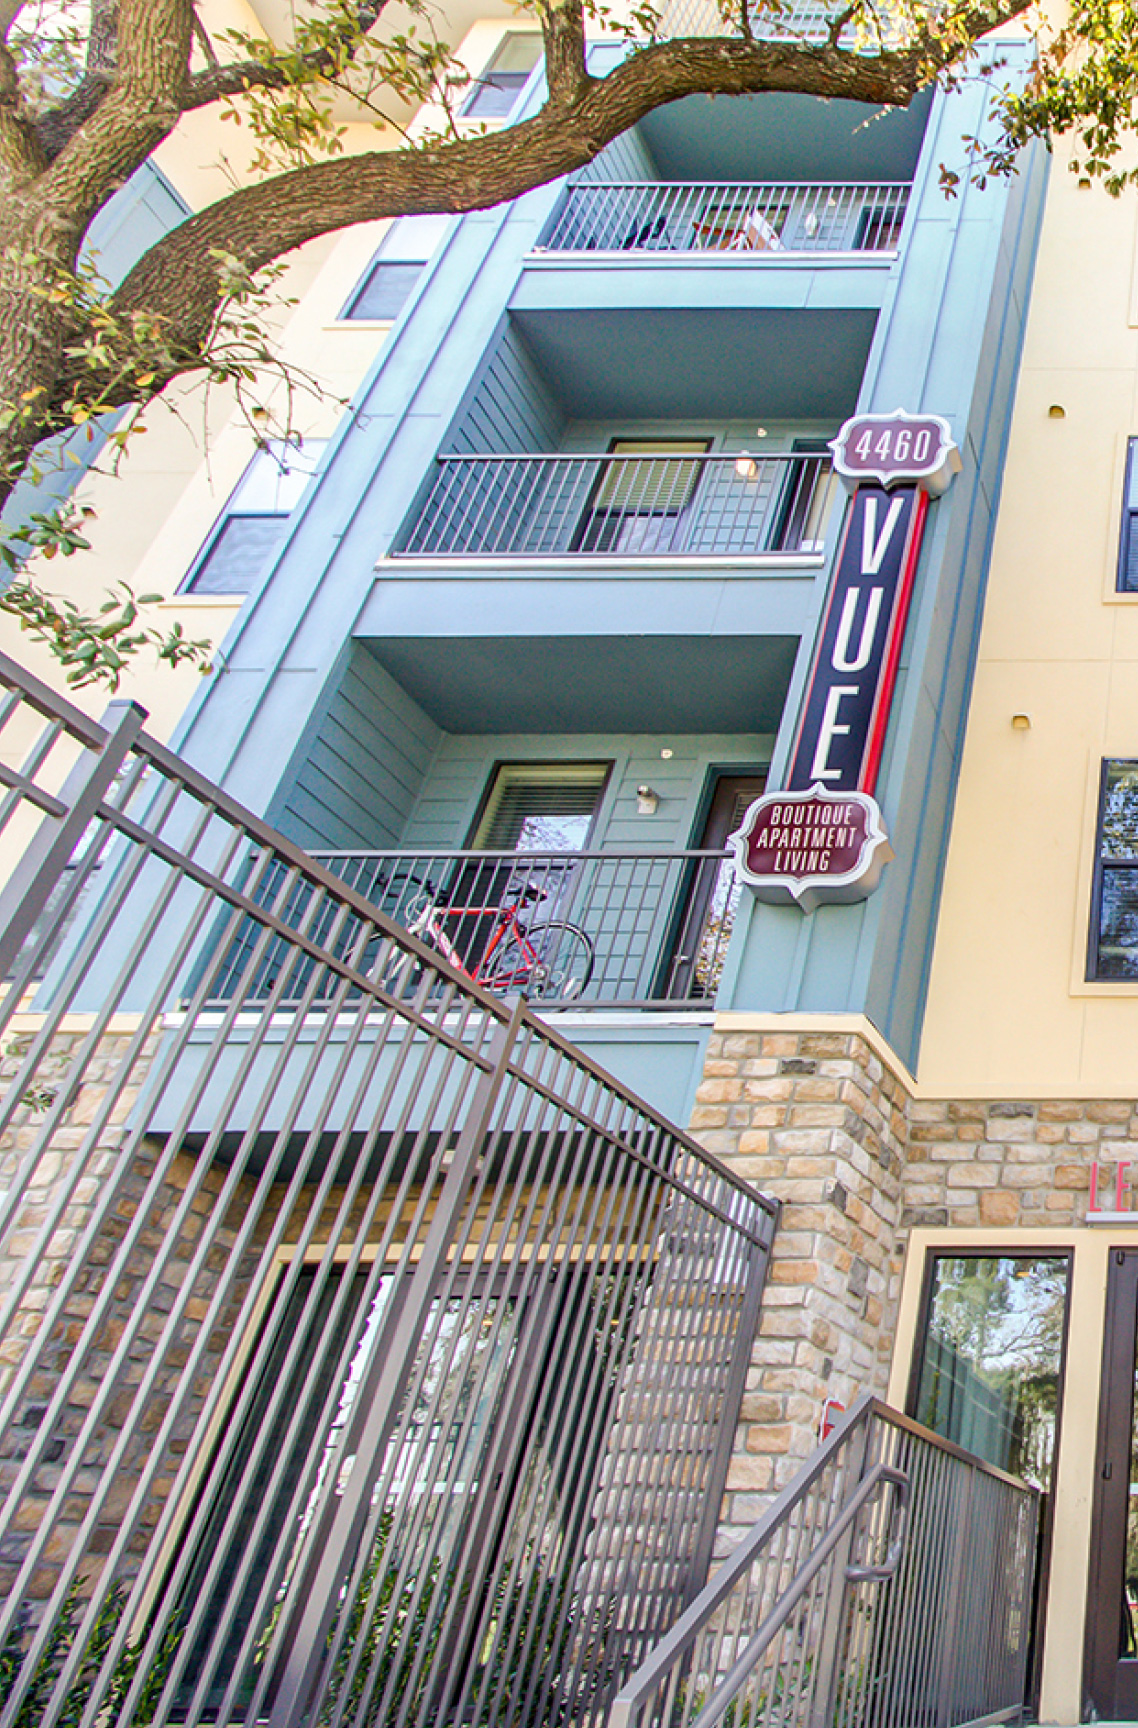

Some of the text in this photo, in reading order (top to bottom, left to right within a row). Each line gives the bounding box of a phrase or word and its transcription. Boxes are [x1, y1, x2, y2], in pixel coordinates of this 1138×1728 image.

[855, 429, 931, 462] 4460
[811, 497, 905, 780] VUE
[770, 805, 853, 825] BOUTIQUE
[756, 827, 857, 848] APARTMENT
[774, 850, 830, 871] LIVING
